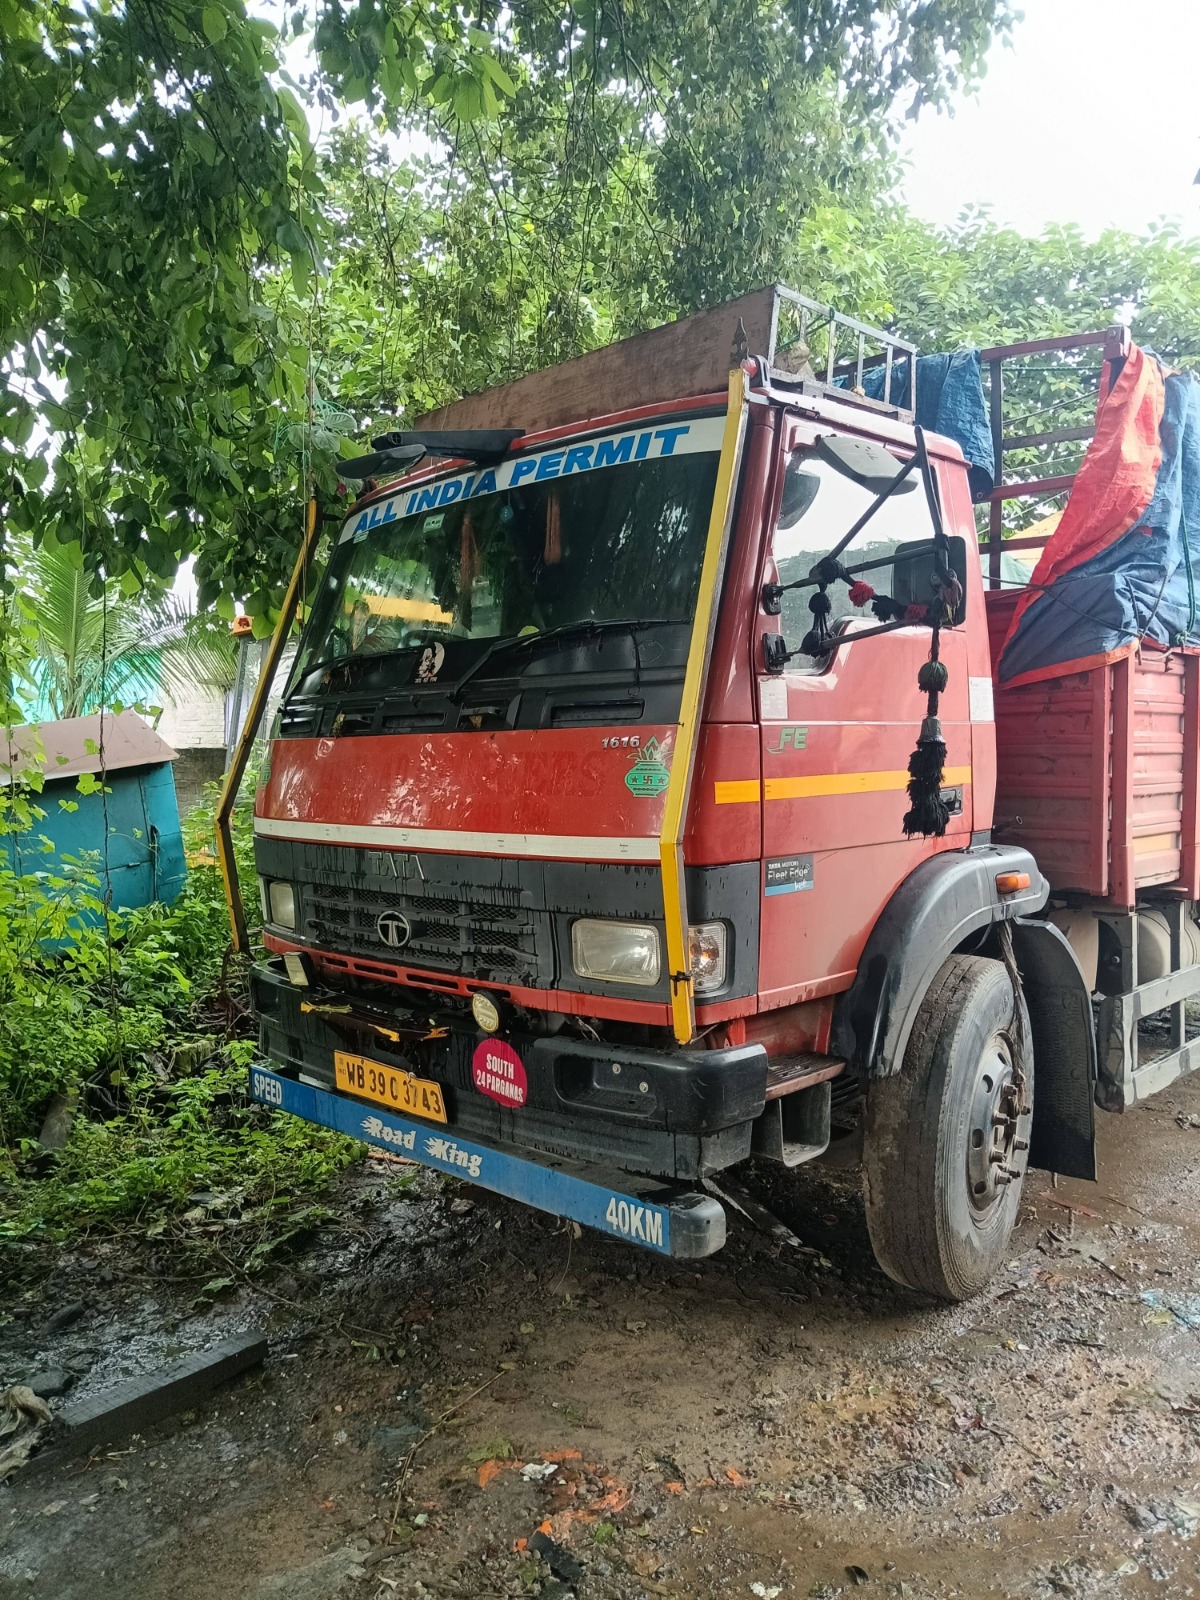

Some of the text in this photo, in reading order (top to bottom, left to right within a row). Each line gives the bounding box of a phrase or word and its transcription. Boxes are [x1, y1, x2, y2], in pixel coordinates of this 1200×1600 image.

[352, 426, 691, 536] ALL INDIA PERMIT
[601, 735, 641, 749] 1616
[772, 727, 809, 752] FE
[368, 851, 425, 880] TATA
[768, 867, 808, 880] Fleet Edge
[781, 860, 799, 868] MOTORS
[346, 1062, 365, 1089] WB
[369, 1068, 386, 1097] 39
[486, 1053, 515, 1080] SOUTH
[254, 1072, 283, 1105] SPEED
[476, 1069, 524, 1103] 24 PARGANAS
[359, 1115, 483, 1178] Road King
[605, 1196, 664, 1247] 40KM
